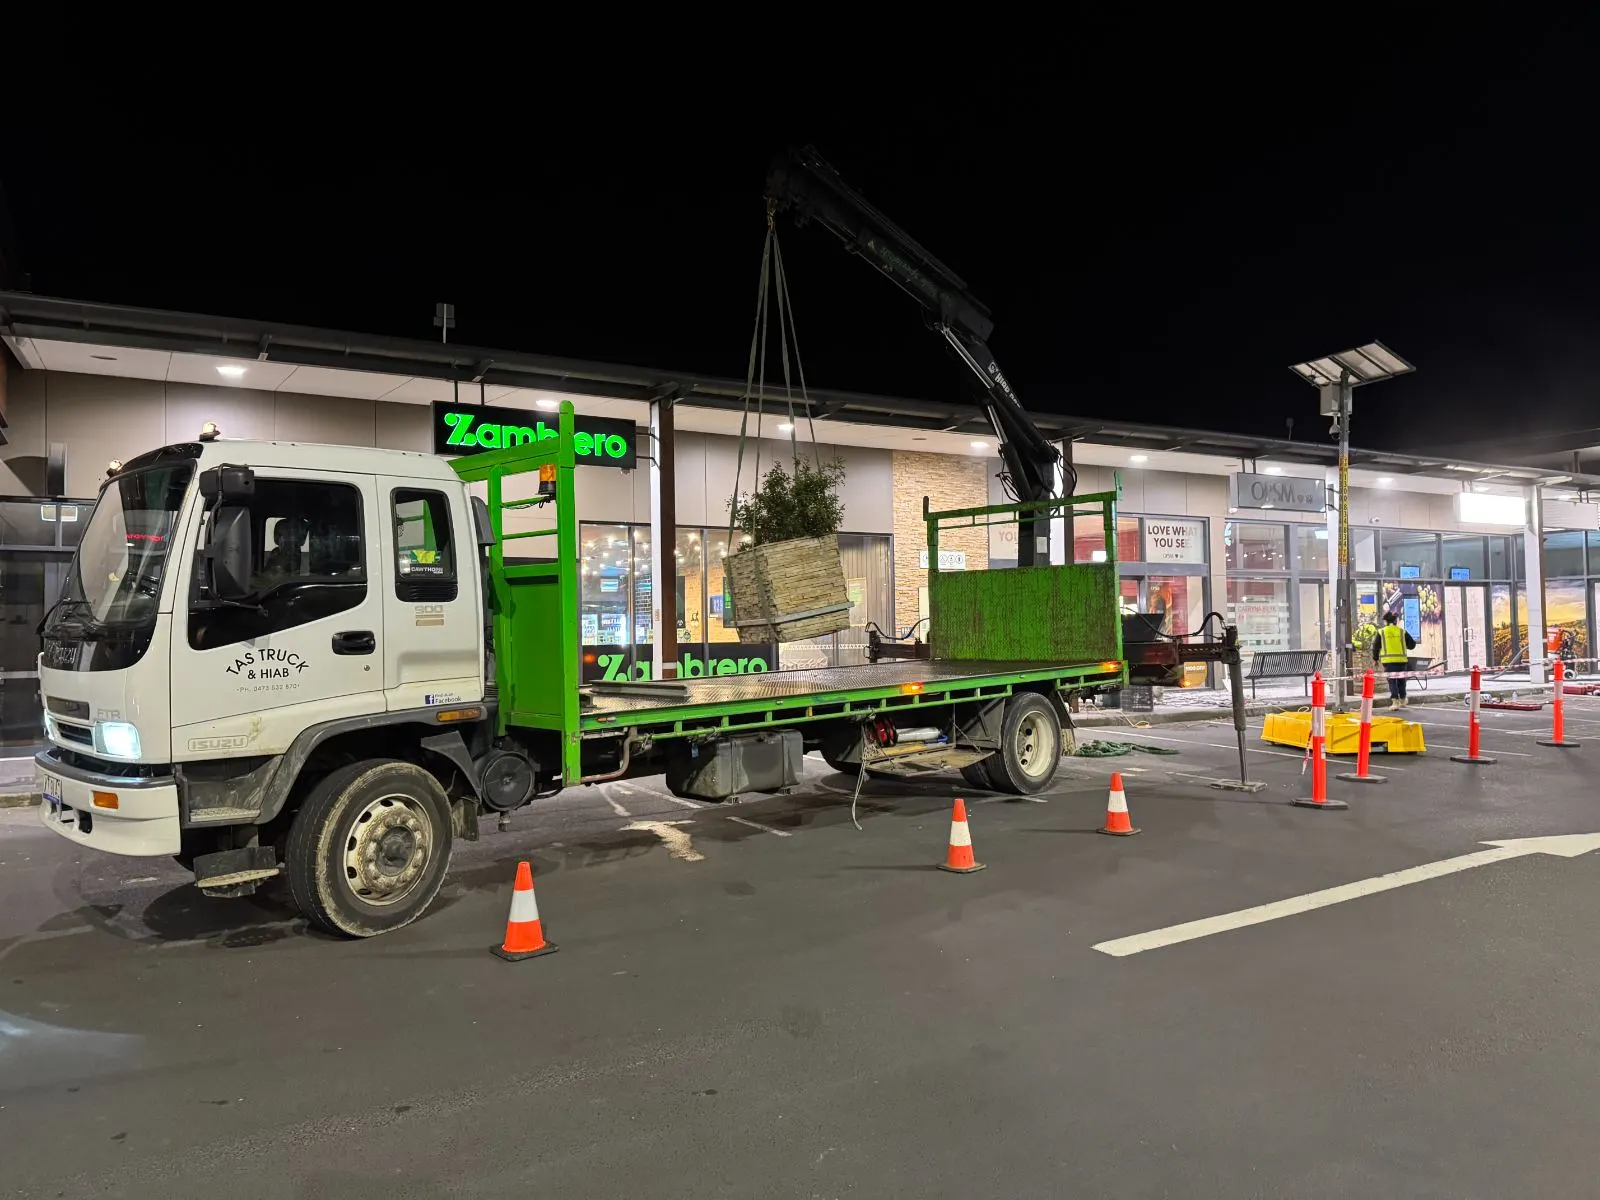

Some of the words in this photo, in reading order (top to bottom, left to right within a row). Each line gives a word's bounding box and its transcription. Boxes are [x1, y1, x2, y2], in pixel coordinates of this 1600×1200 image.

[444, 412, 627, 458] Zambero
[999, 531, 1018, 542] YO
[1147, 525, 1171, 536] LOVE
[1153, 538, 1173, 548] YOU
[225, 652, 255, 676] TAS
[258, 648, 310, 675] TRUCK
[597, 652, 768, 682] Zabrero
[247, 669, 256, 680] &
[260, 667, 290, 679] HIAB
[192, 738, 245, 750] ISUZU
